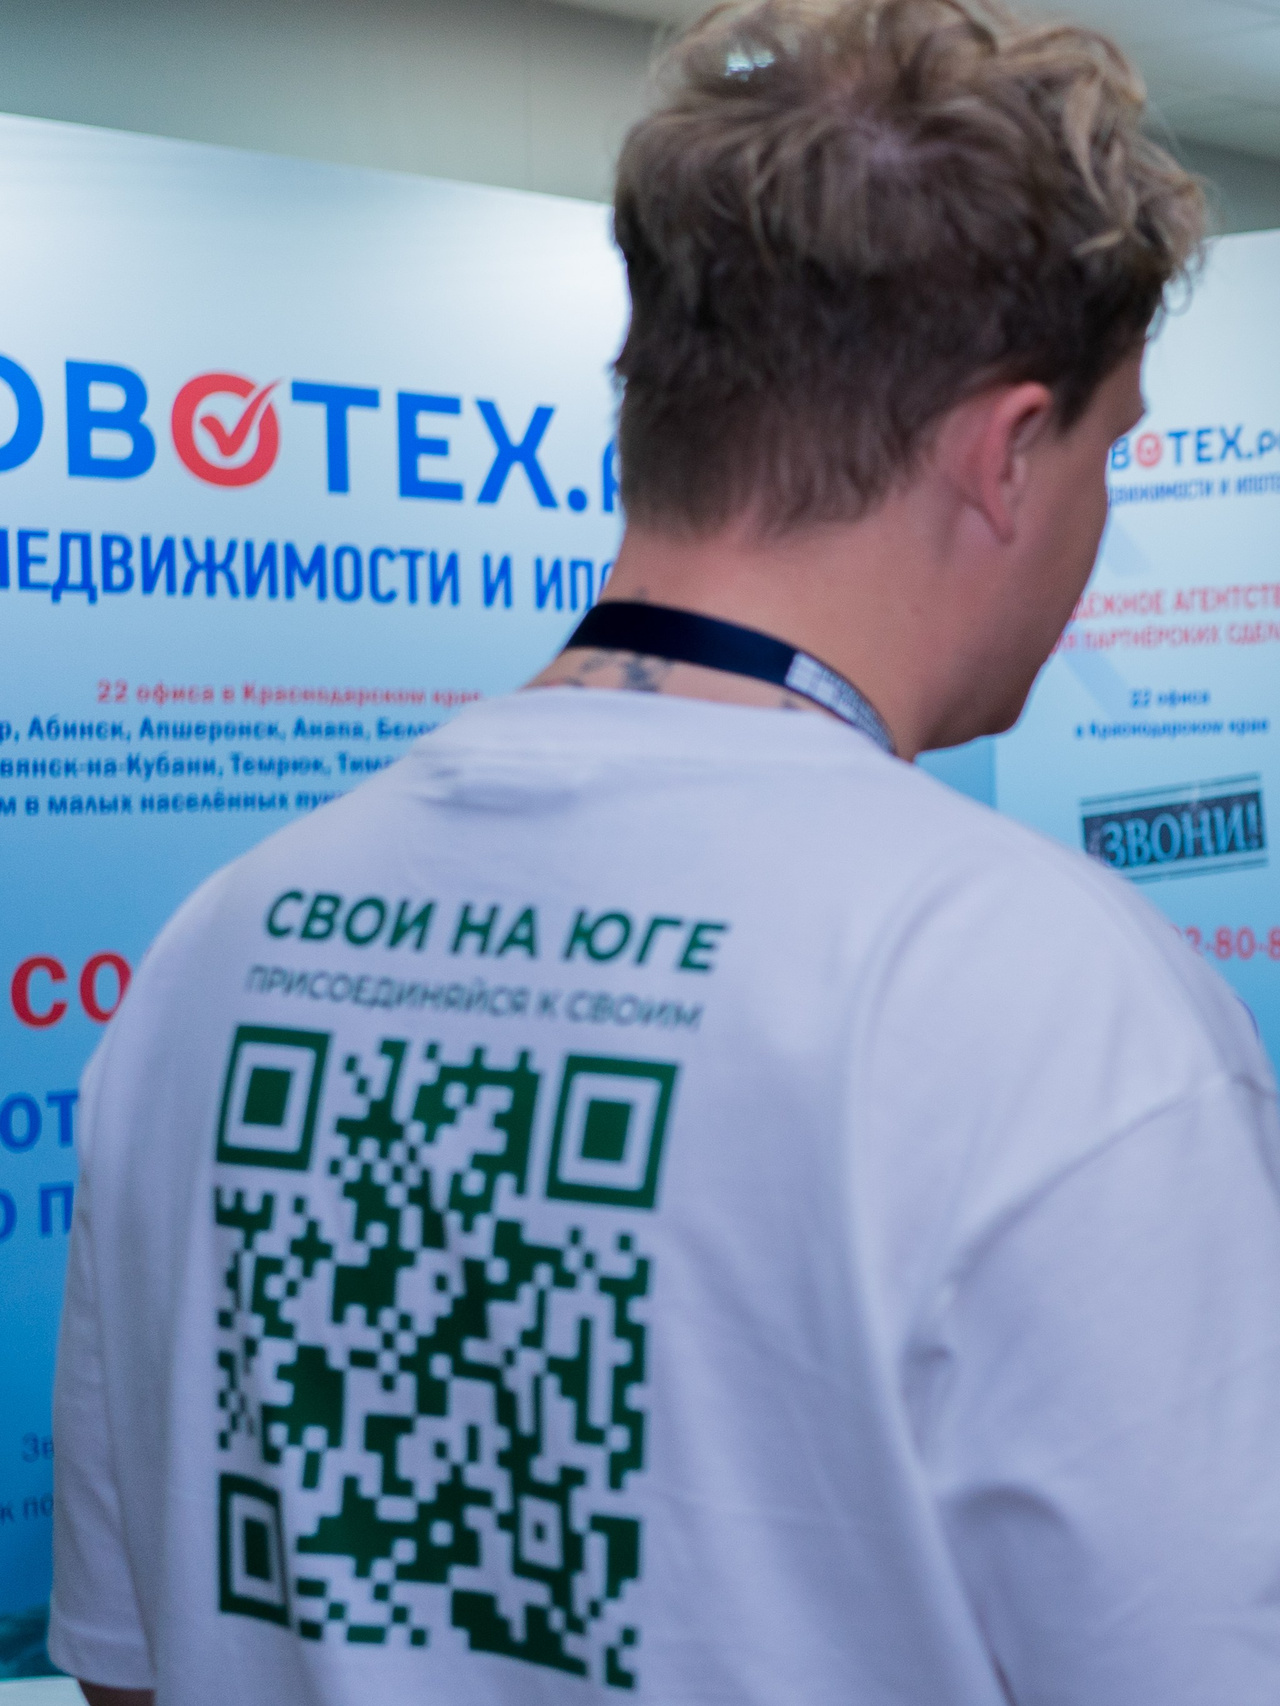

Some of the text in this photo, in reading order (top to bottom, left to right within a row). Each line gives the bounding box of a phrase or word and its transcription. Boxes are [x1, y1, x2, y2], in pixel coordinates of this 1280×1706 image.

[483, 553, 513, 610] И
[98, 679, 128, 704] 22
[136, 681, 214, 708] офиса
[28, 714, 131, 744] Абинск,
[48, 795, 133, 816] малых
[140, 786, 288, 815] населённых
[1101, 801, 1260, 867] ЗВОНИ!
[265, 890, 731, 972] СВОИ НА ЮГЕ
[246, 963, 704, 1032] ПРИСОЕДИНЯЙСЯ К СВОИМ
